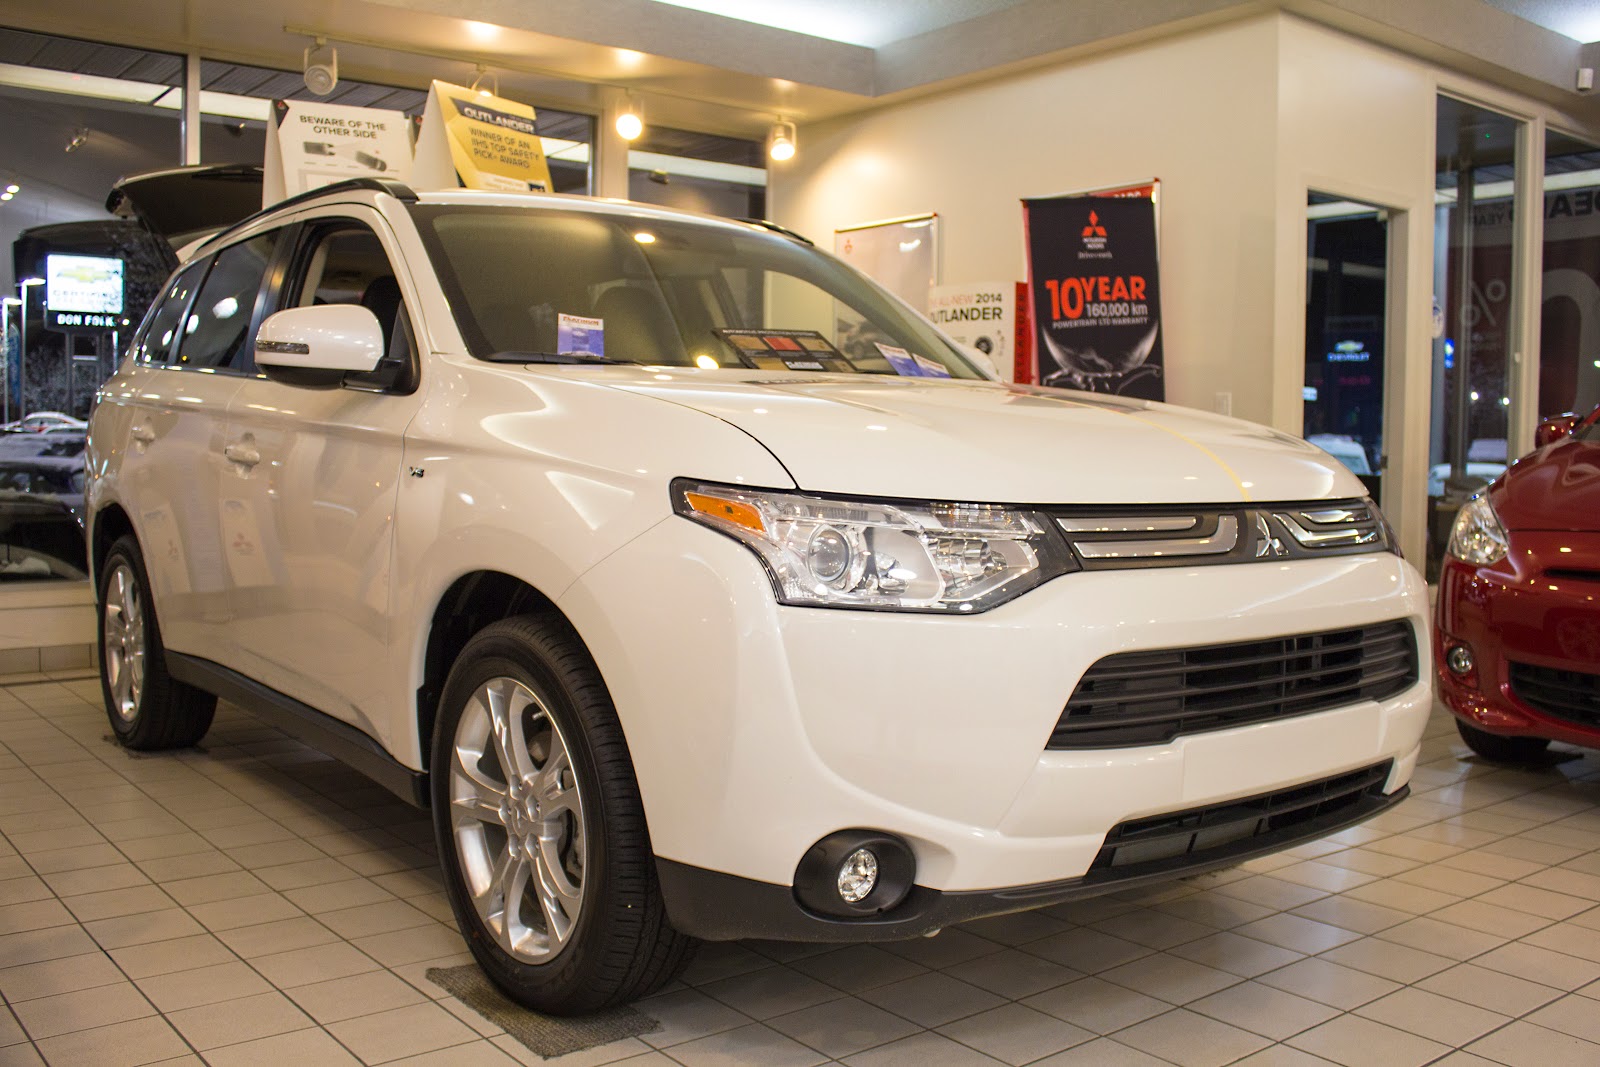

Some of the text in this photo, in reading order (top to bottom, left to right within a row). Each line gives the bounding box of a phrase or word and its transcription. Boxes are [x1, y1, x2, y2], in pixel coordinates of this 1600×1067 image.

[300, 115, 386, 131] BEWARE OF THE
[464, 107, 535, 134] OUTLANDER
[313, 125, 377, 139] OTHER SIDE
[469, 126, 531, 150] WINNER OF AN
[490, 142, 507, 153] TOP
[508, 146, 540, 161] SAFETY
[500, 155, 530, 169] AWARD
[975, 293, 1003, 304] 2014
[1045, 275, 1147, 320] 10 YEAR
[1086, 302, 1148, 317] 160,000 km
[57, 313, 114, 327] DON FOLK
[1053, 319, 1098, 330] POWERTRAIN
[1112, 317, 1148, 325] WARRANTY
